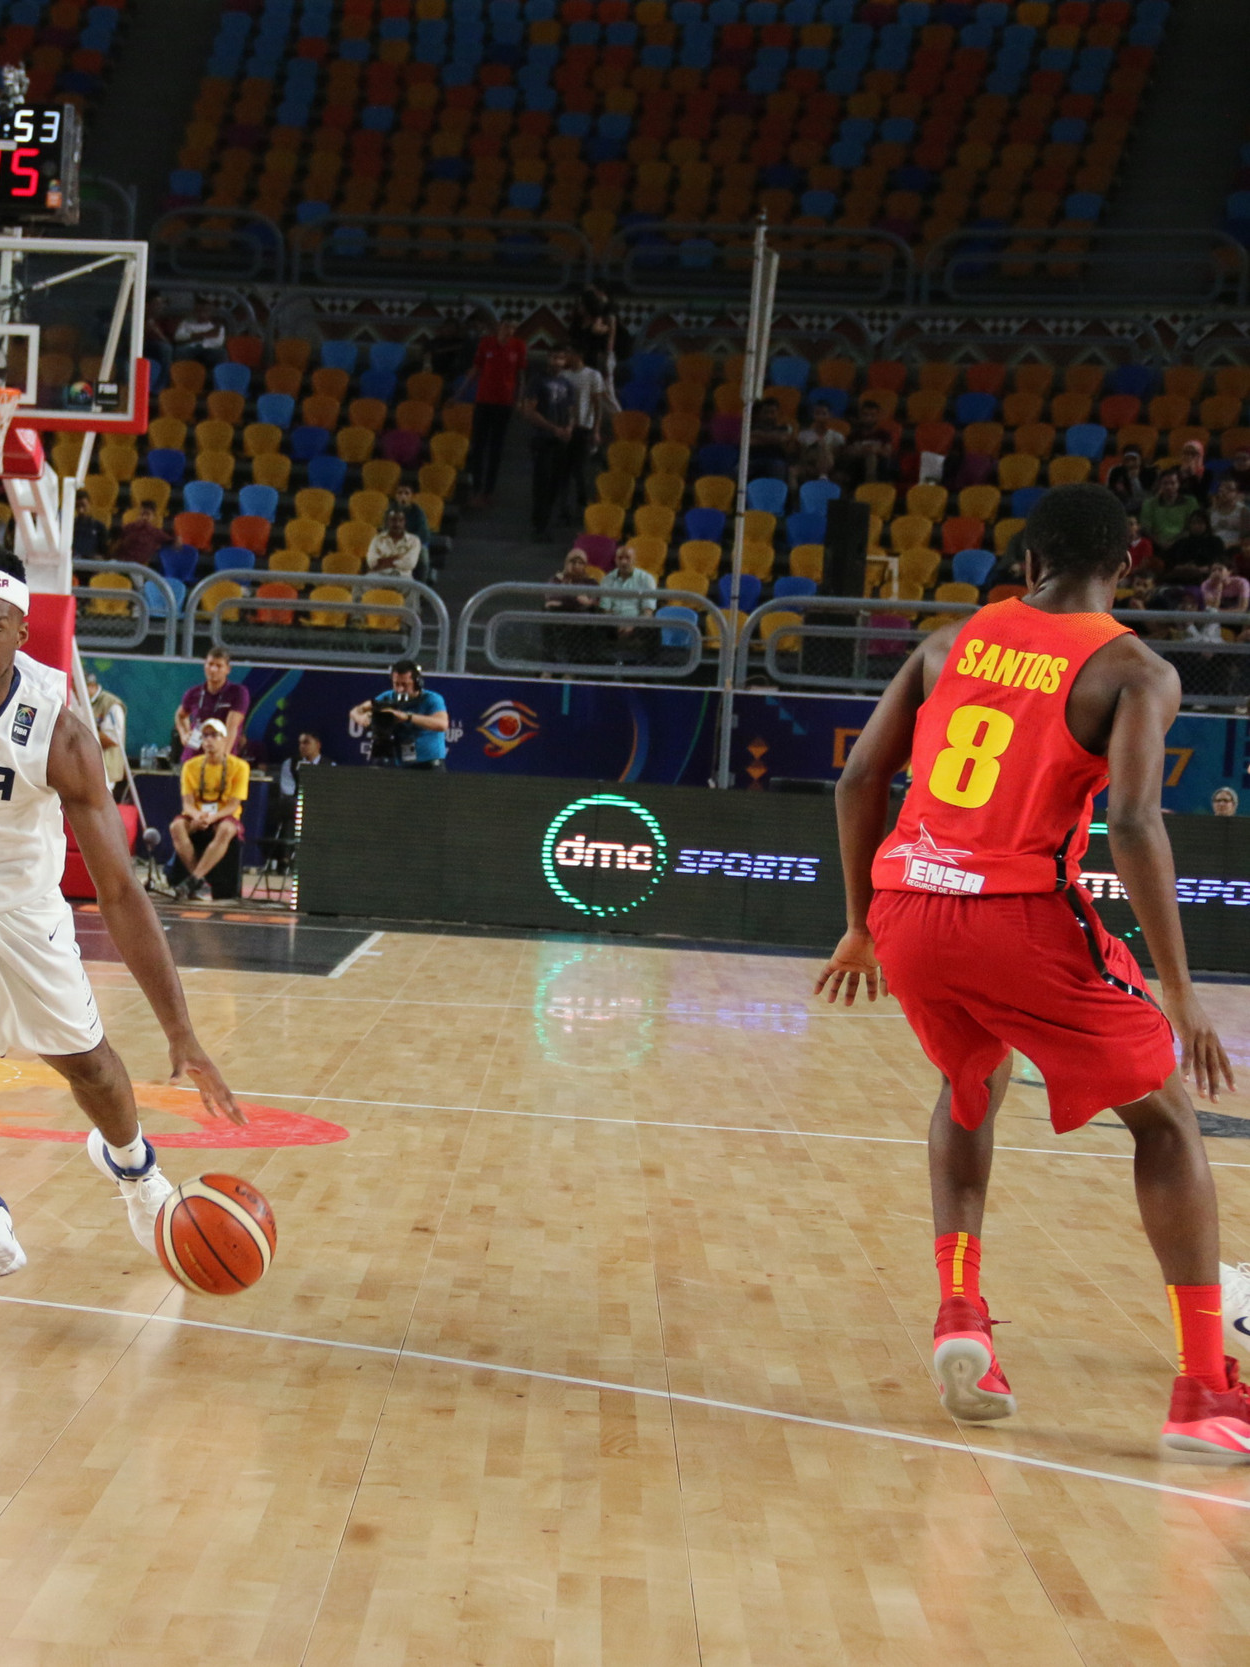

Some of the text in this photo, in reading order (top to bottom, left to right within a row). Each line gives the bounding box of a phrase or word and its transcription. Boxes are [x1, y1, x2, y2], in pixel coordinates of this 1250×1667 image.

[956, 638, 1069, 694] SANTOS
[928, 704, 1015, 809] 8
[555, 835, 821, 882] dmc SPORTS
[909, 858, 985, 894] ENSA
